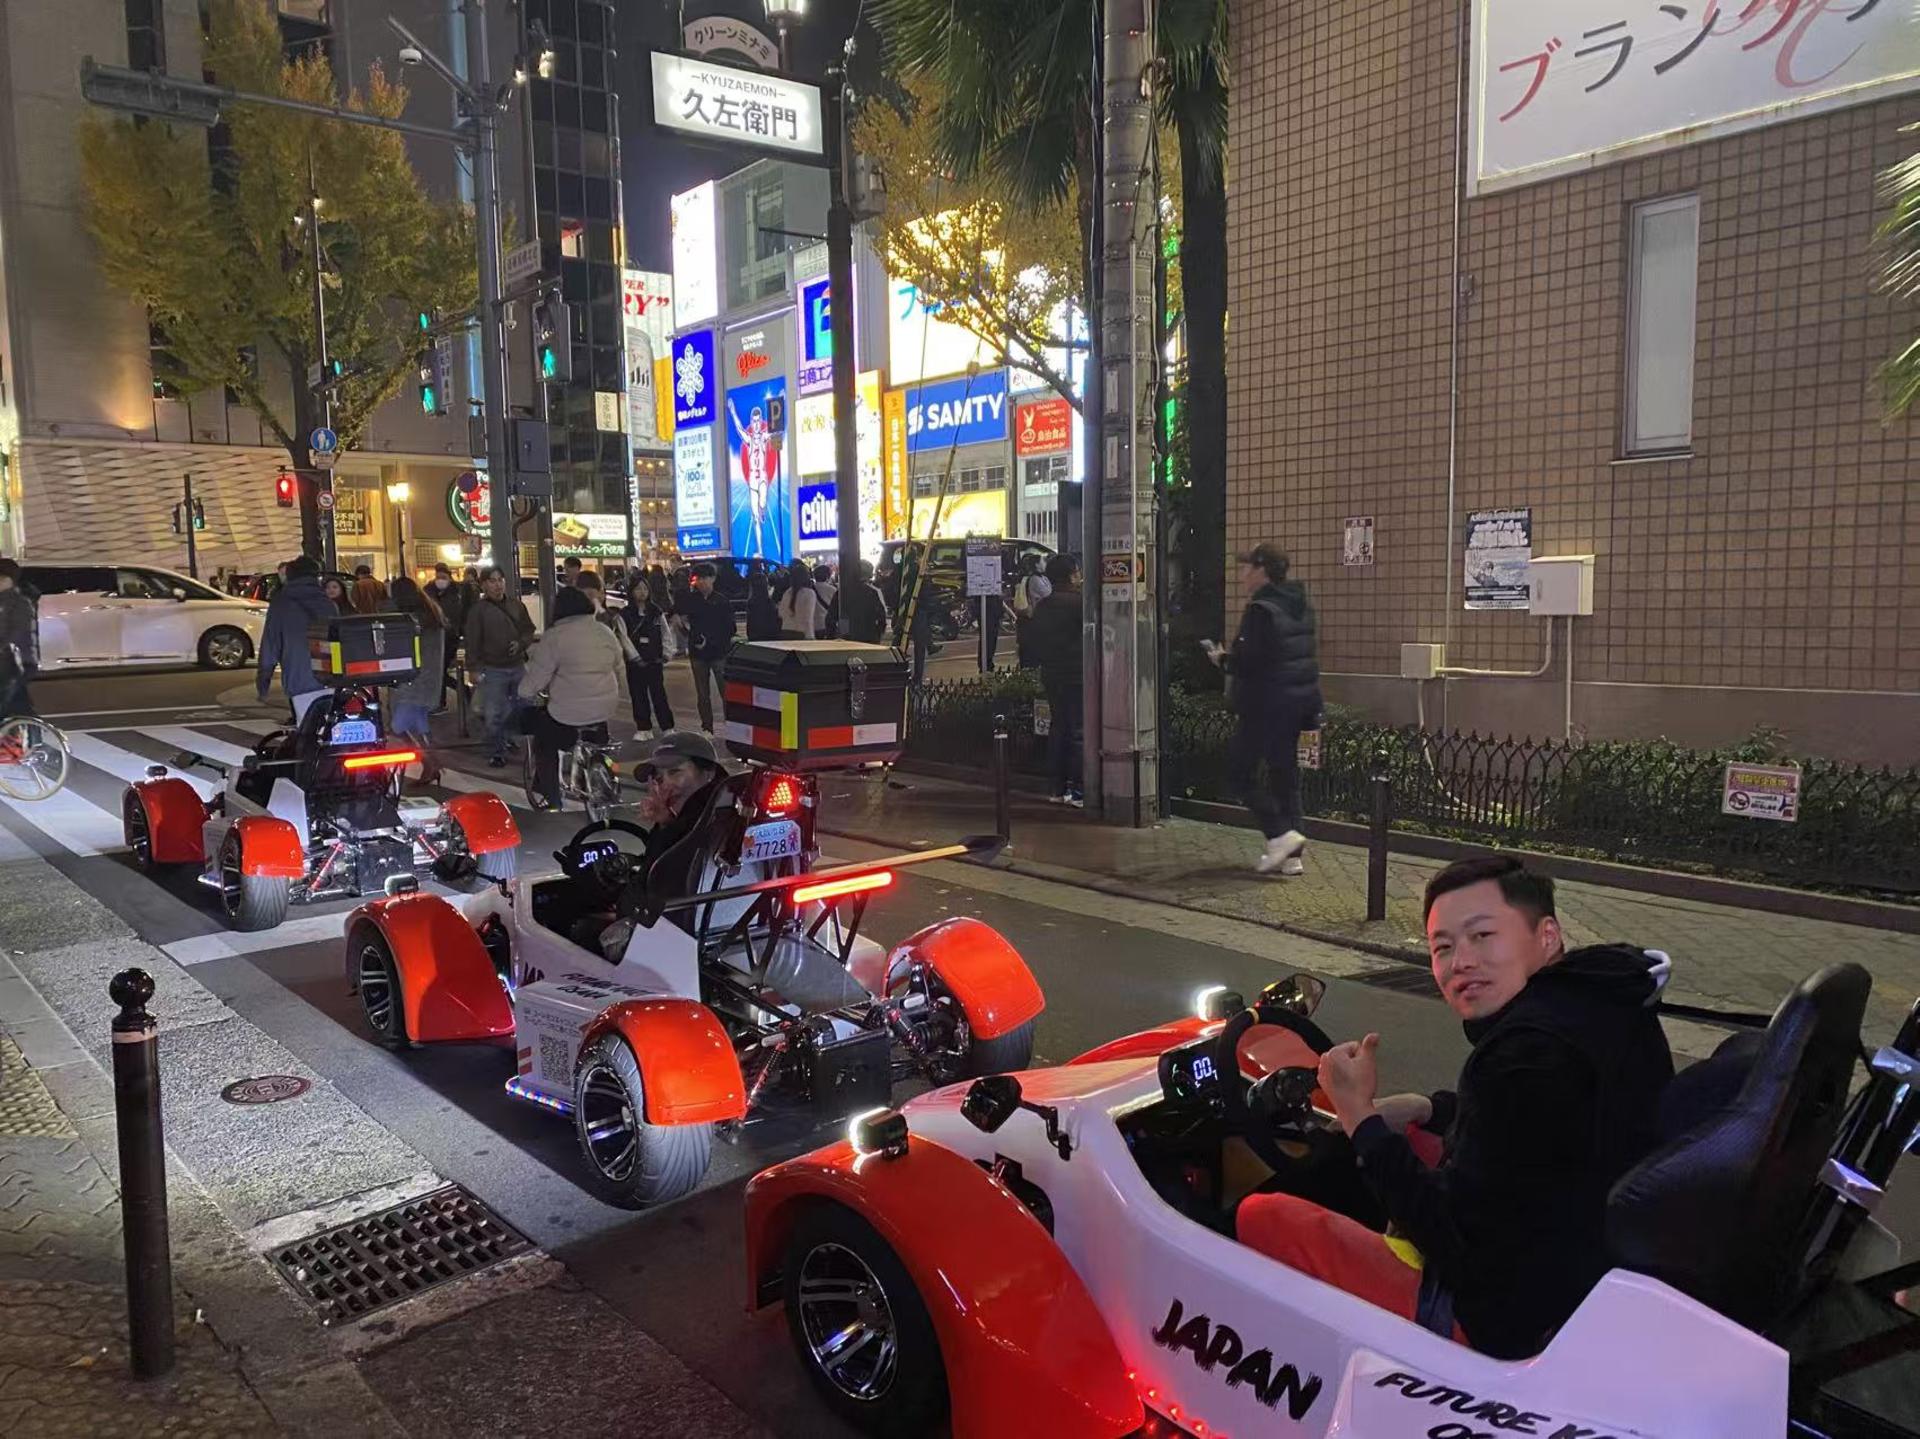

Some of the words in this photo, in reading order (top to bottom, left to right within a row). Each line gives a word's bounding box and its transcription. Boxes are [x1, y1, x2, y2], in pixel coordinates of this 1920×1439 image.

[694, 26, 770, 60] クリーンミナミ
[682, 88, 797, 141] 久左衛門
[927, 392, 1004, 431] SAMTY
[755, 838, 787, 857] 7728
[1151, 1298, 1322, 1421] JAPAN
[1373, 1372, 1552, 1435] FUTURE
